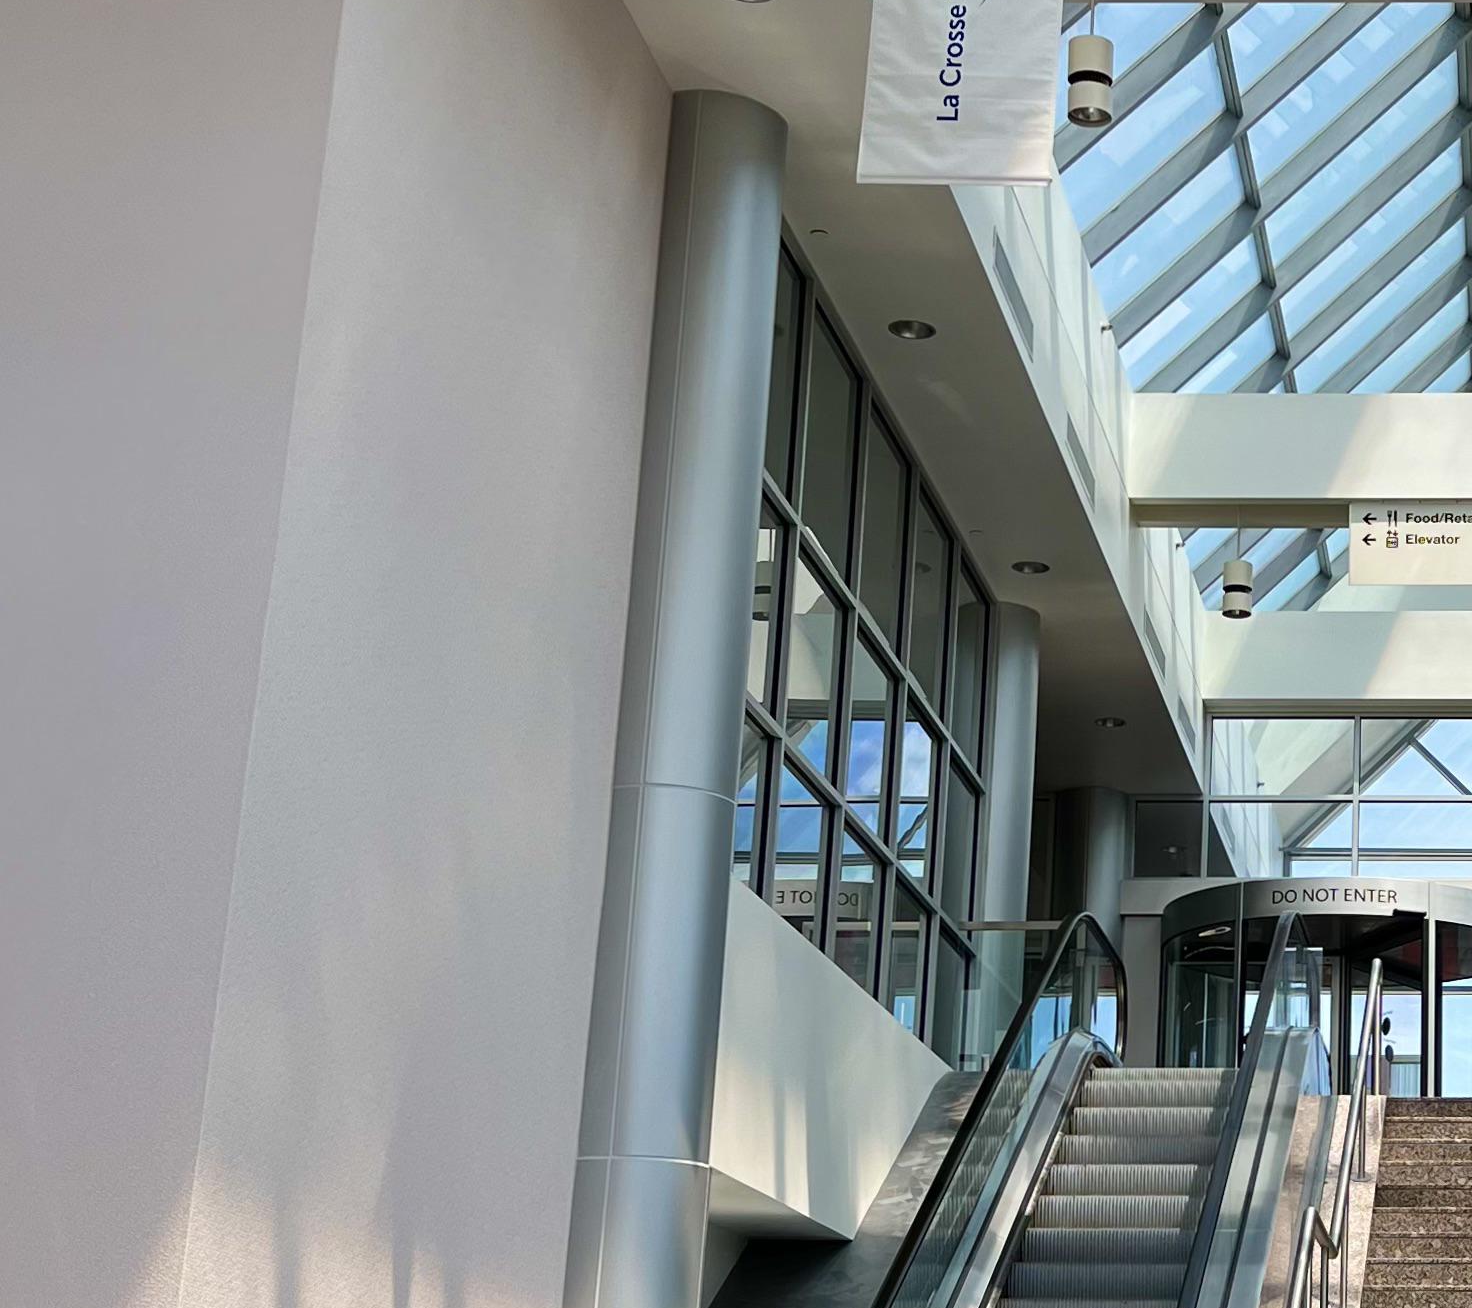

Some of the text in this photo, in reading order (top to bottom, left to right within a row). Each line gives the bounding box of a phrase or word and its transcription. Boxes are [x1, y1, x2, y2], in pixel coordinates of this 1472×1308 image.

[939, 4, 967, 88] Crosse
[936, 94, 960, 122] La
[1405, 534, 1460, 545] Elevator
[1272, 888, 1397, 904] DO NOT ENTER
